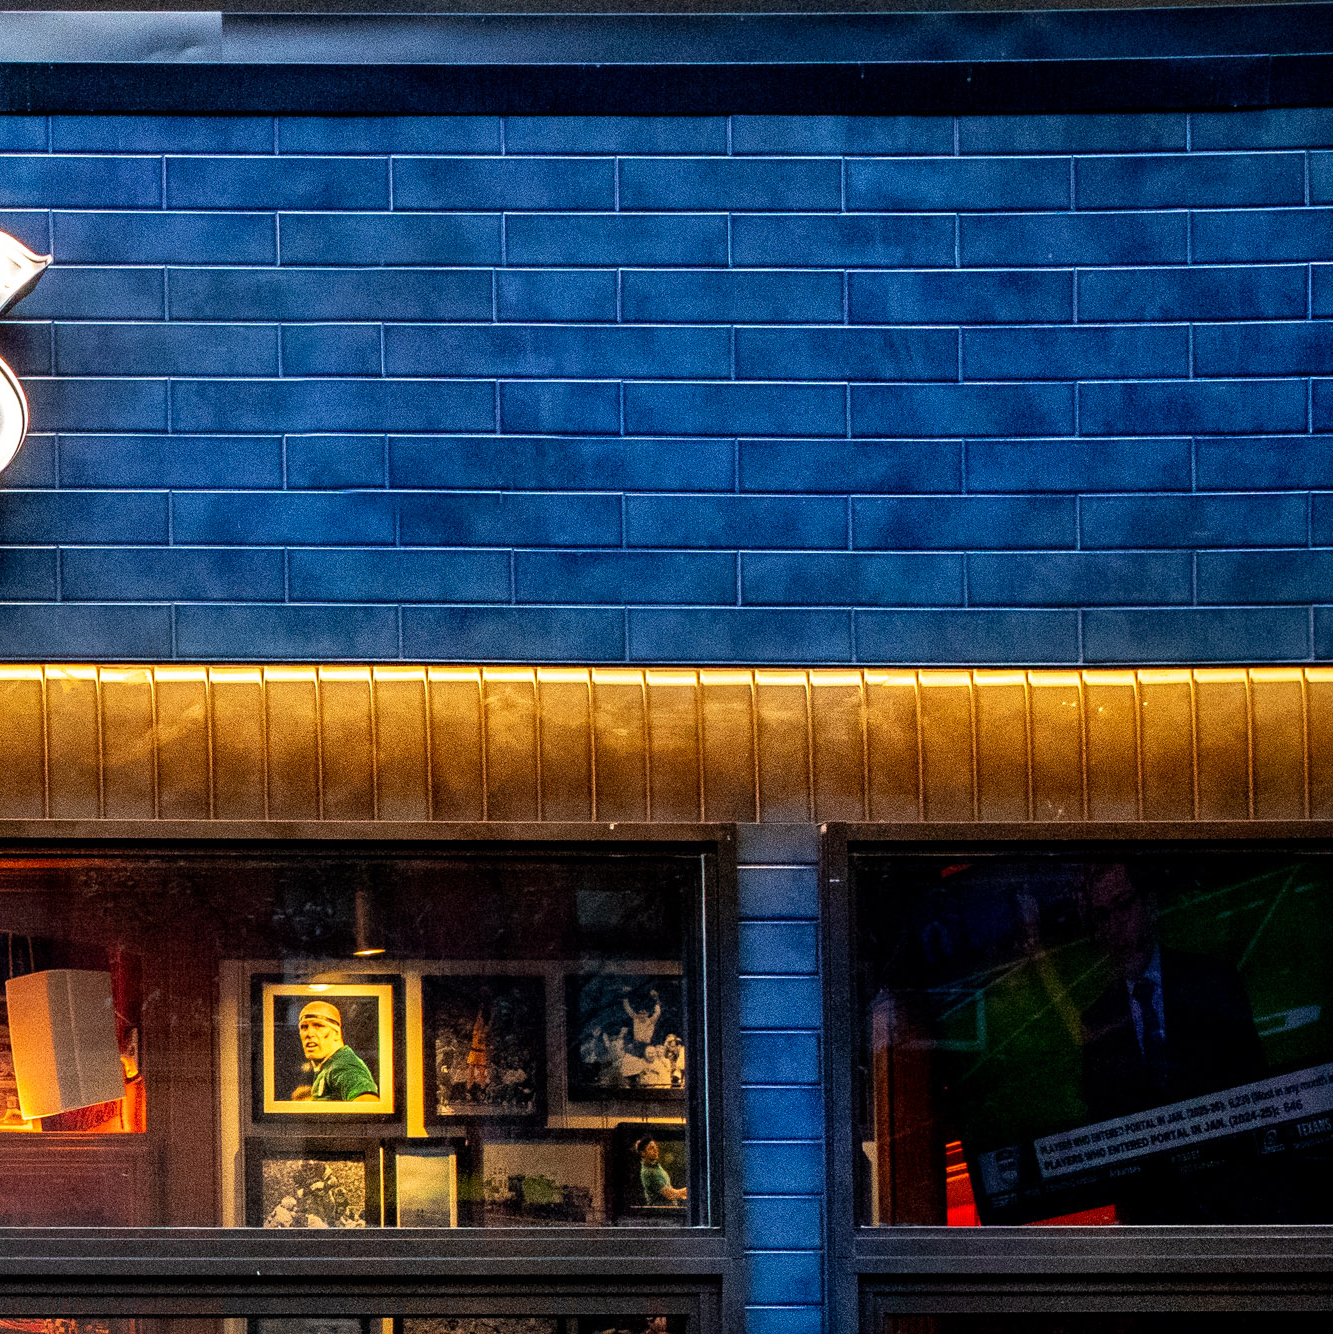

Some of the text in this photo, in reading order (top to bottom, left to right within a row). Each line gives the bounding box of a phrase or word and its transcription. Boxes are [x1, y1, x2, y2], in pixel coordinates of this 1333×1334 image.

[1040, 1139, 1072, 1155] PLAYERS
[1072, 1134, 1090, 1147] WHO
[1090, 1125, 1124, 1142] ENTERED
[1124, 1118, 1155, 1134] PORTAL
[1044, 1152, 1083, 1171] PLAYERS
[1084, 1147, 1106, 1161] WHO
[1106, 1136, 1149, 1155] ENTERED
[1150, 1126, 1189, 1145] PORTAL
[1189, 1123, 1202, 1135] IN
